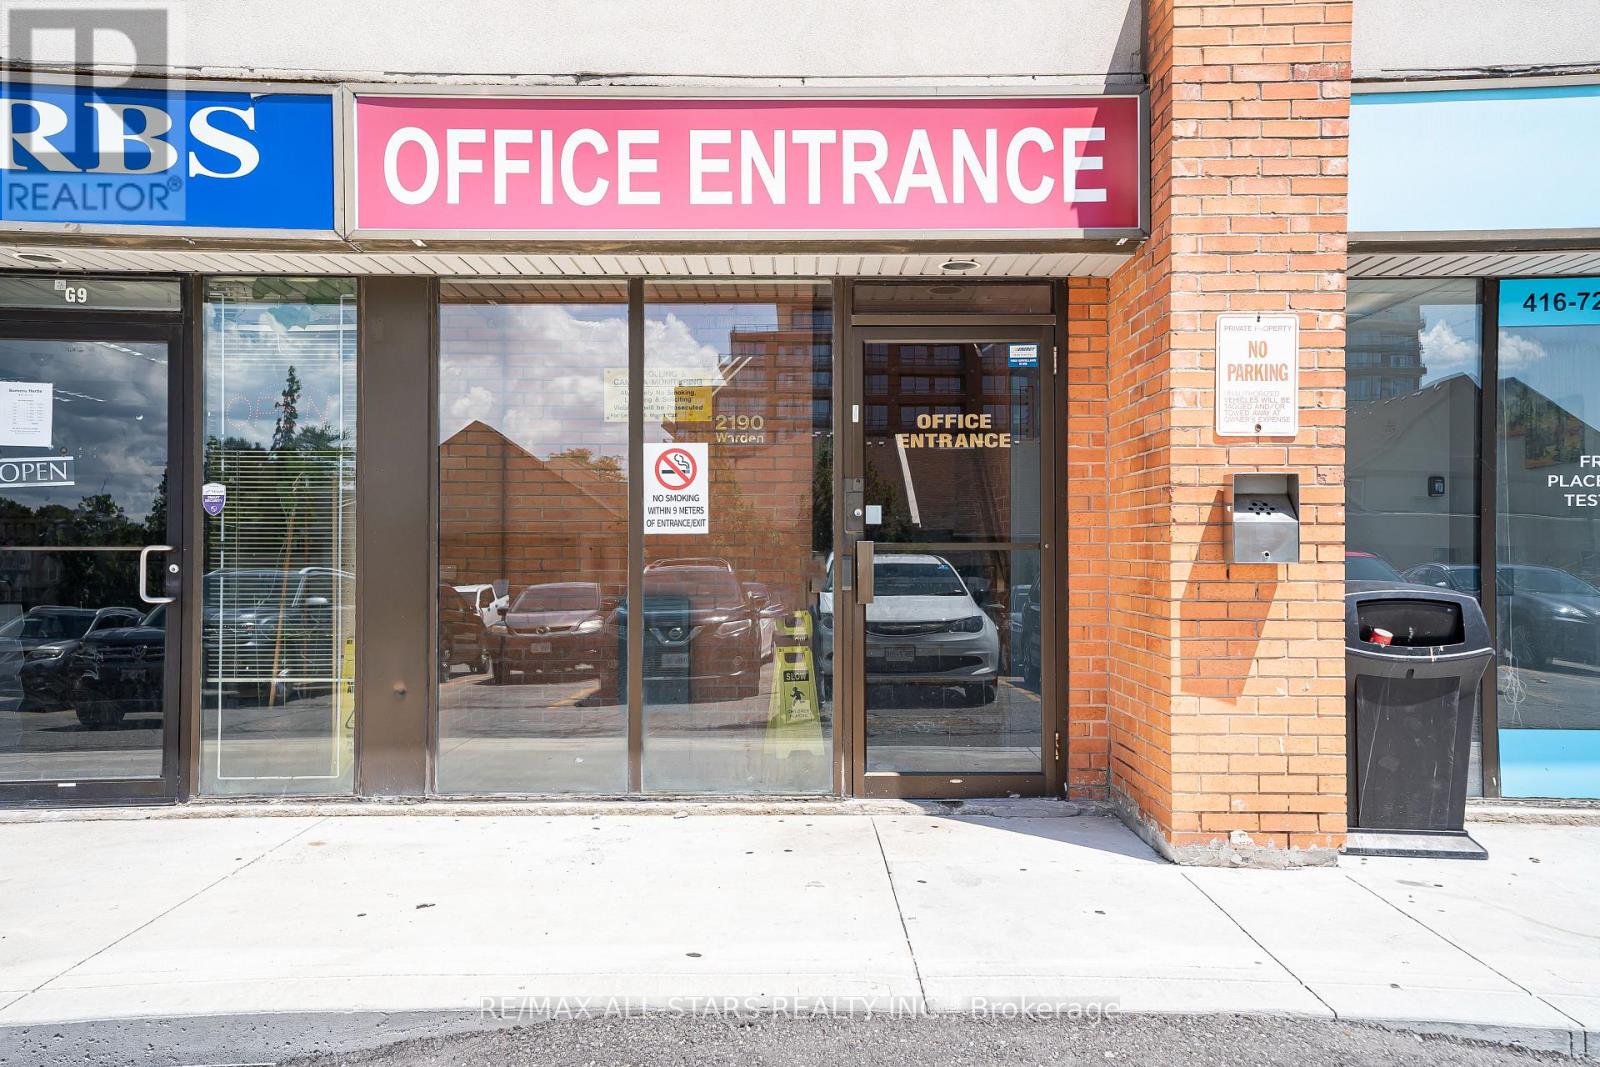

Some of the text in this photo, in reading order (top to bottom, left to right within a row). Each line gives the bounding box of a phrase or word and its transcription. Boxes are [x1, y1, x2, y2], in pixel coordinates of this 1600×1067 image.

[384, 126, 1107, 206] OFFICE ENTRANCE
[65, 287, 87, 303] G9
[1248, 340, 1268, 358] NO
[1227, 363, 1288, 381] PARKING
[715, 415, 764, 430] 2190
[917, 414, 991, 429] OFFICE
[898, 433, 1011, 448] ENTRANCE
[0, 461, 67, 482] OPEN
[652, 494, 700, 502] NO SMOKING
[1563, 494, 1600, 507] TES
[647, 506, 705, 515] WITHIN 9 METERS
[646, 518, 706, 528] OF ENTRANCE/EXIT
[786, 672, 807, 680] SLOW
